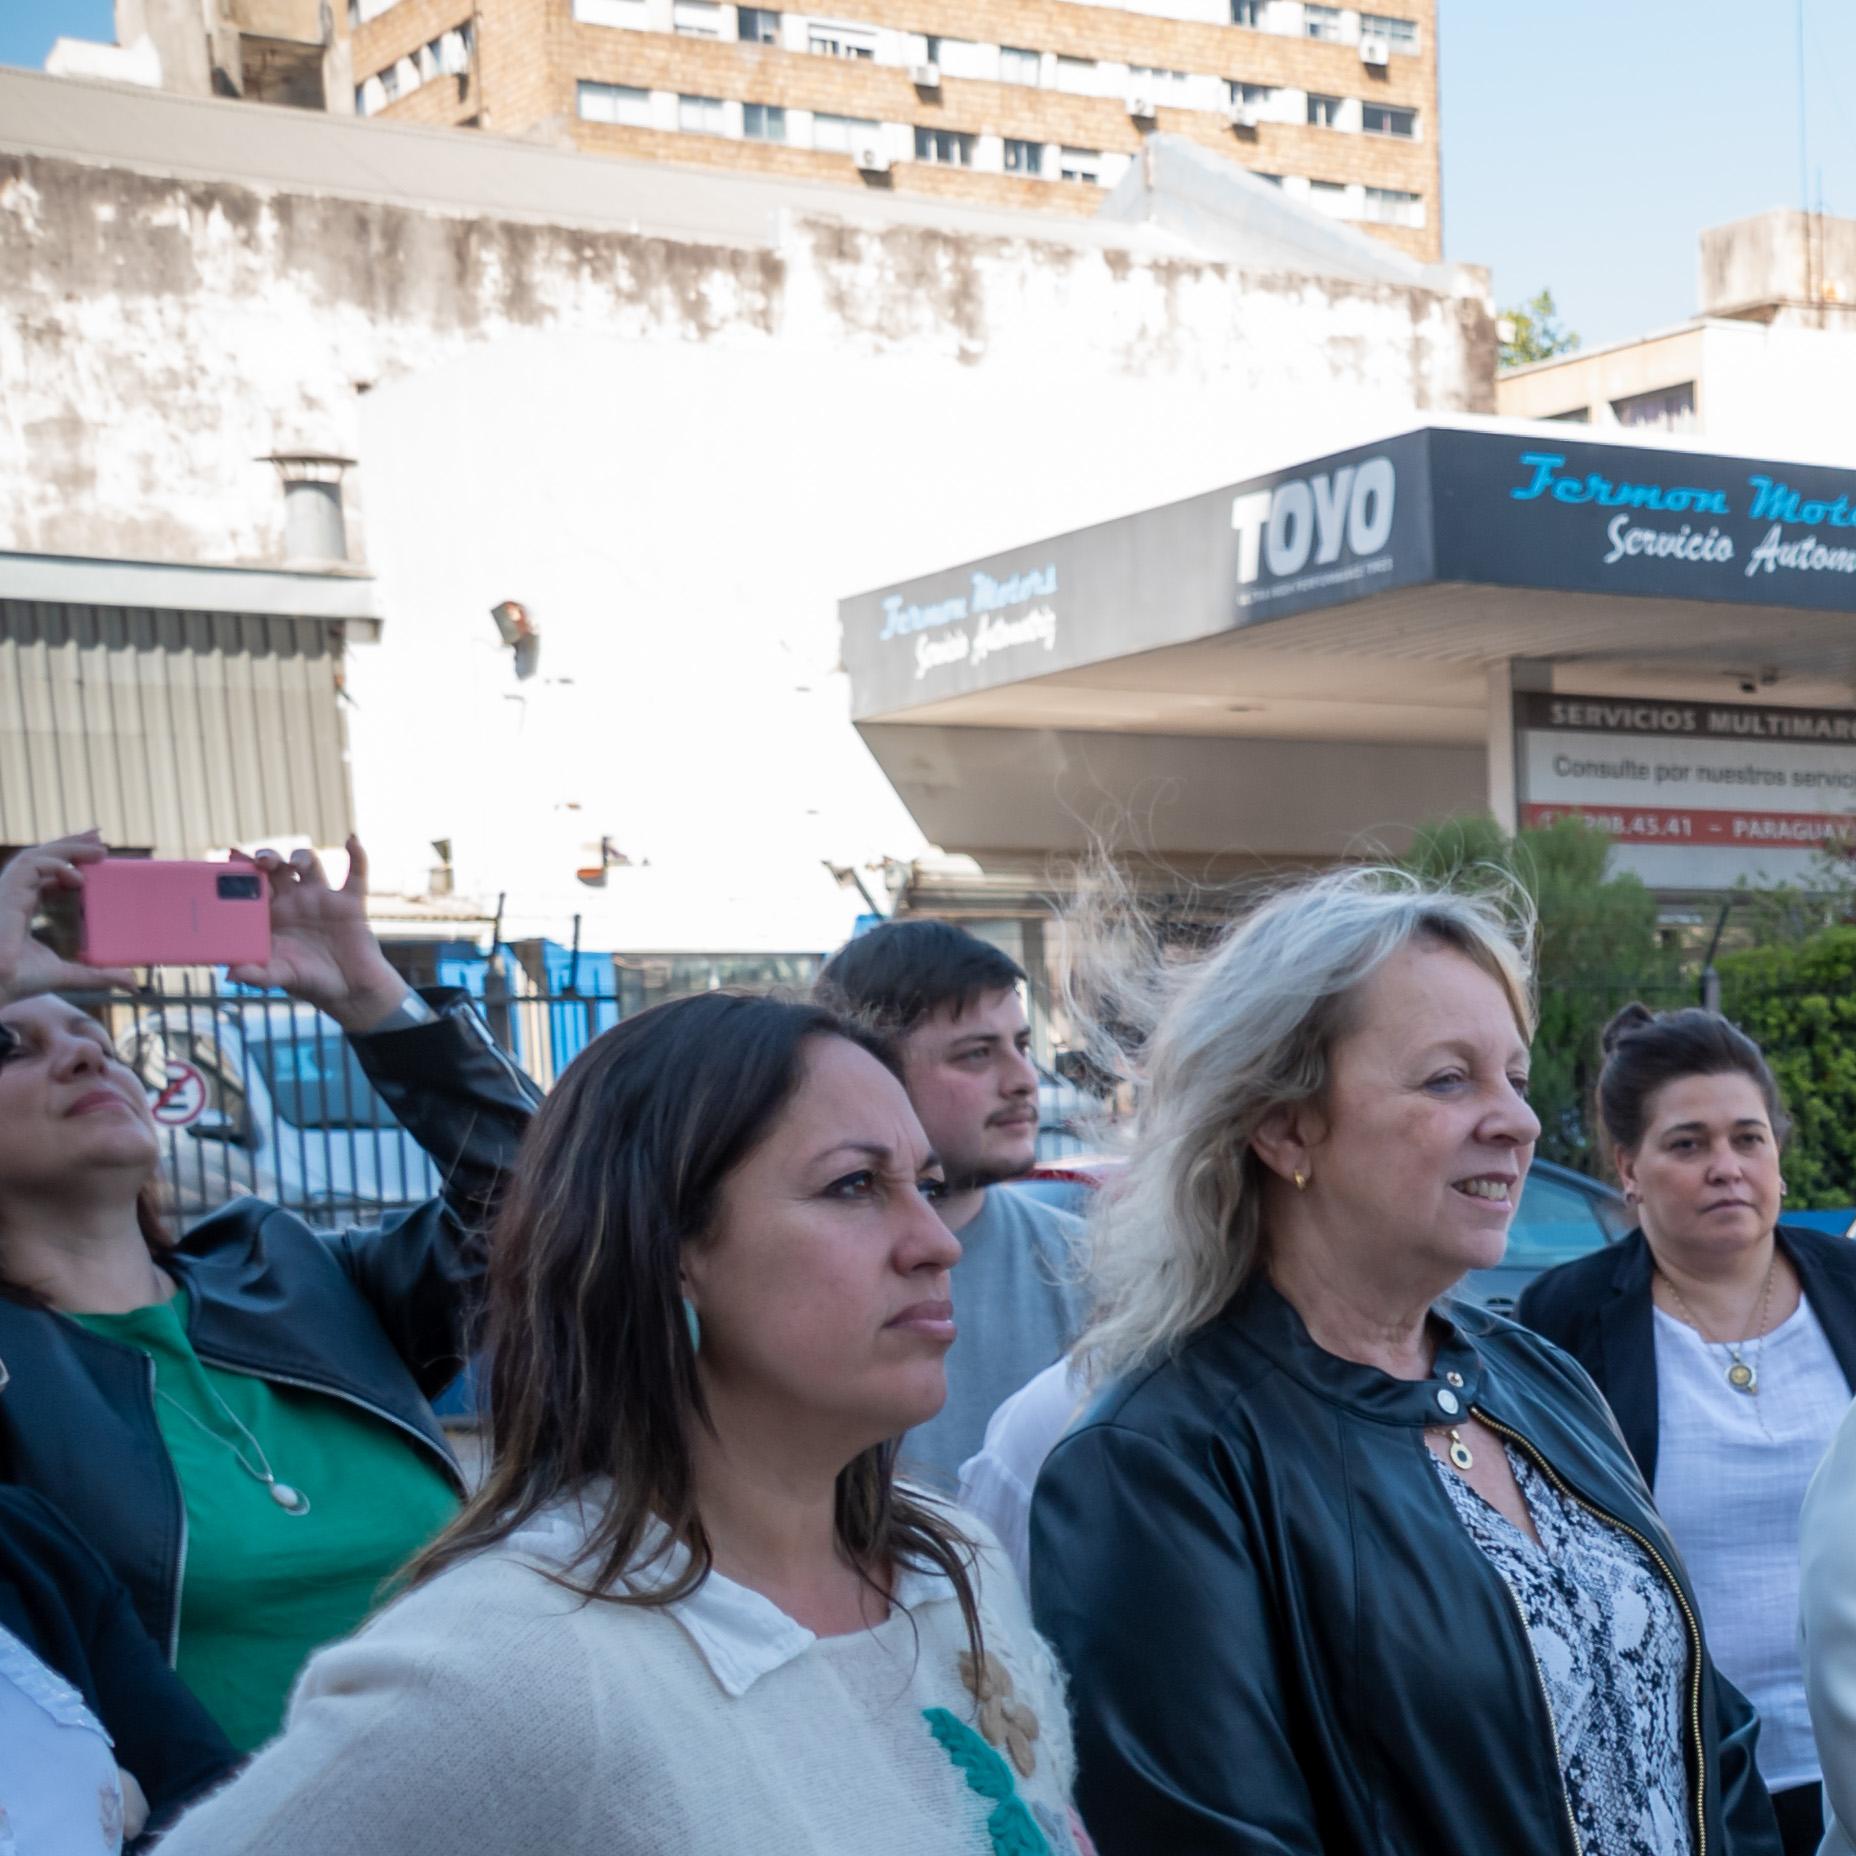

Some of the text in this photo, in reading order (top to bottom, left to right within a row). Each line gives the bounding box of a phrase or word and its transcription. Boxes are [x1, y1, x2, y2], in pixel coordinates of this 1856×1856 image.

[1511, 452, 1730, 515] Fermon
[1231, 456, 1396, 584] TOYO
[1604, 514, 1734, 564] Servicio
[1551, 703, 1697, 731] SERVICIOS
[1553, 755, 1650, 781] Consulte
[1655, 763, 1692, 785] por
[1696, 764, 1787, 786] nuestros
